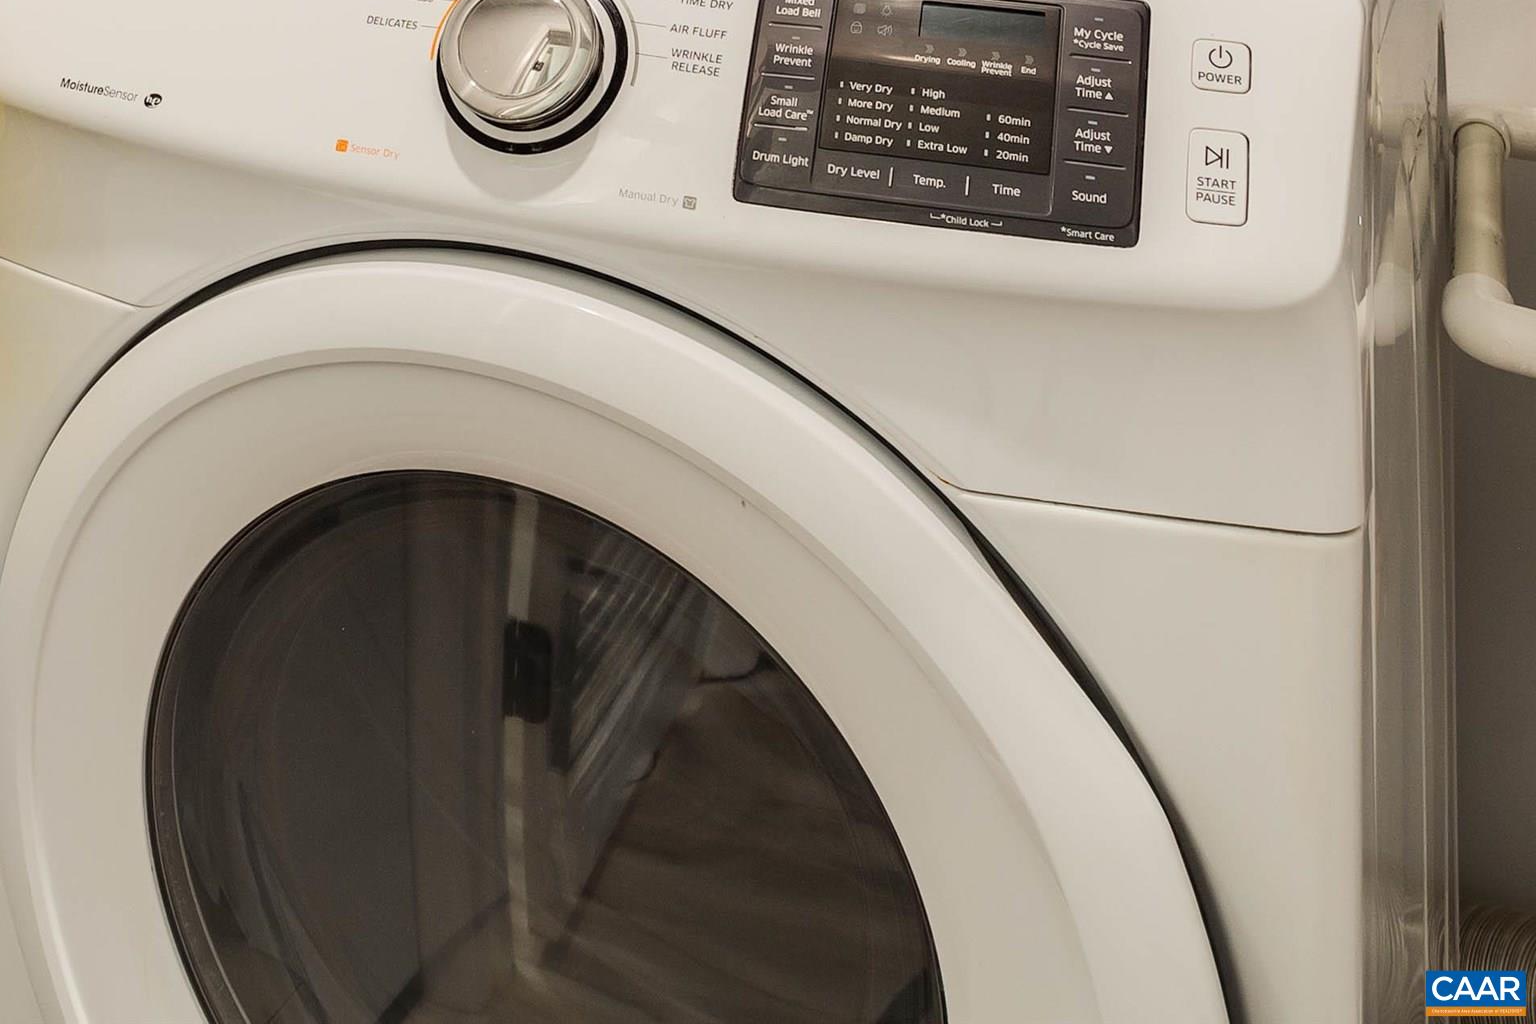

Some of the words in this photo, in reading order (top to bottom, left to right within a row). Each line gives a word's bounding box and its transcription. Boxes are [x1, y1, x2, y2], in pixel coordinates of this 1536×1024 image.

[710, 0, 733, 10] DRY
[776, 5, 799, 16] Load
[802, 7, 821, 18] Bell
[367, 15, 418, 29] DELICATES
[670, 24, 689, 34] AIR
[692, 27, 727, 39] FLUFF
[1074, 27, 1091, 39] My
[1094, 30, 1123, 41] Cycle
[775, 43, 813, 55] Wrinkle
[1104, 43, 1124, 52] Save
[671, 48, 723, 64] WRINKLE
[773, 54, 812, 68] Prevent
[915, 55, 941, 65] Drying
[672, 61, 720, 77] RELEASE
[947, 58, 976, 68] Cooling
[982, 60, 1012, 70] Wrinkle
[981, 67, 1012, 77] Prevent
[1021, 66, 1036, 75] End
[1076, 75, 1112, 88] Adjust
[1198, 72, 1242, 86] POWER
[849, 81, 872, 94] Very
[875, 84, 893, 95] Dry
[922, 88, 945, 100] High
[1075, 88, 1102, 100] Time
[771, 95, 798, 107] Small
[848, 98, 873, 109] More
[875, 100, 894, 112] Dry
[758, 106, 783, 119] Load
[920, 105, 960, 118] Medium
[846, 115, 882, 127] Normal
[884, 118, 902, 131] Dry
[998, 115, 1032, 127] 60min
[919, 122, 940, 134] Low
[844, 132, 872, 145] Damp
[875, 135, 894, 148] Dry
[997, 132, 1030, 145] 40min
[1075, 128, 1111, 142] Adjust
[918, 140, 943, 152] Extra
[946, 143, 967, 154] Low
[1074, 141, 1102, 154] Time
[752, 150, 780, 164] Drum
[783, 153, 809, 168] Light
[996, 150, 1029, 163] 20min
[827, 164, 847, 178] Dry
[851, 166, 880, 180] Level
[913, 174, 946, 189] Temp.
[1196, 176, 1236, 190] START
[992, 183, 1022, 197] Time
[1072, 189, 1107, 204] Sound
[619, 188, 656, 201] Manual
[659, 194, 679, 207] Dry
[1196, 192, 1236, 206] PAUSE
[970, 217, 989, 228] Lock
[1095, 231, 1115, 242] Care
